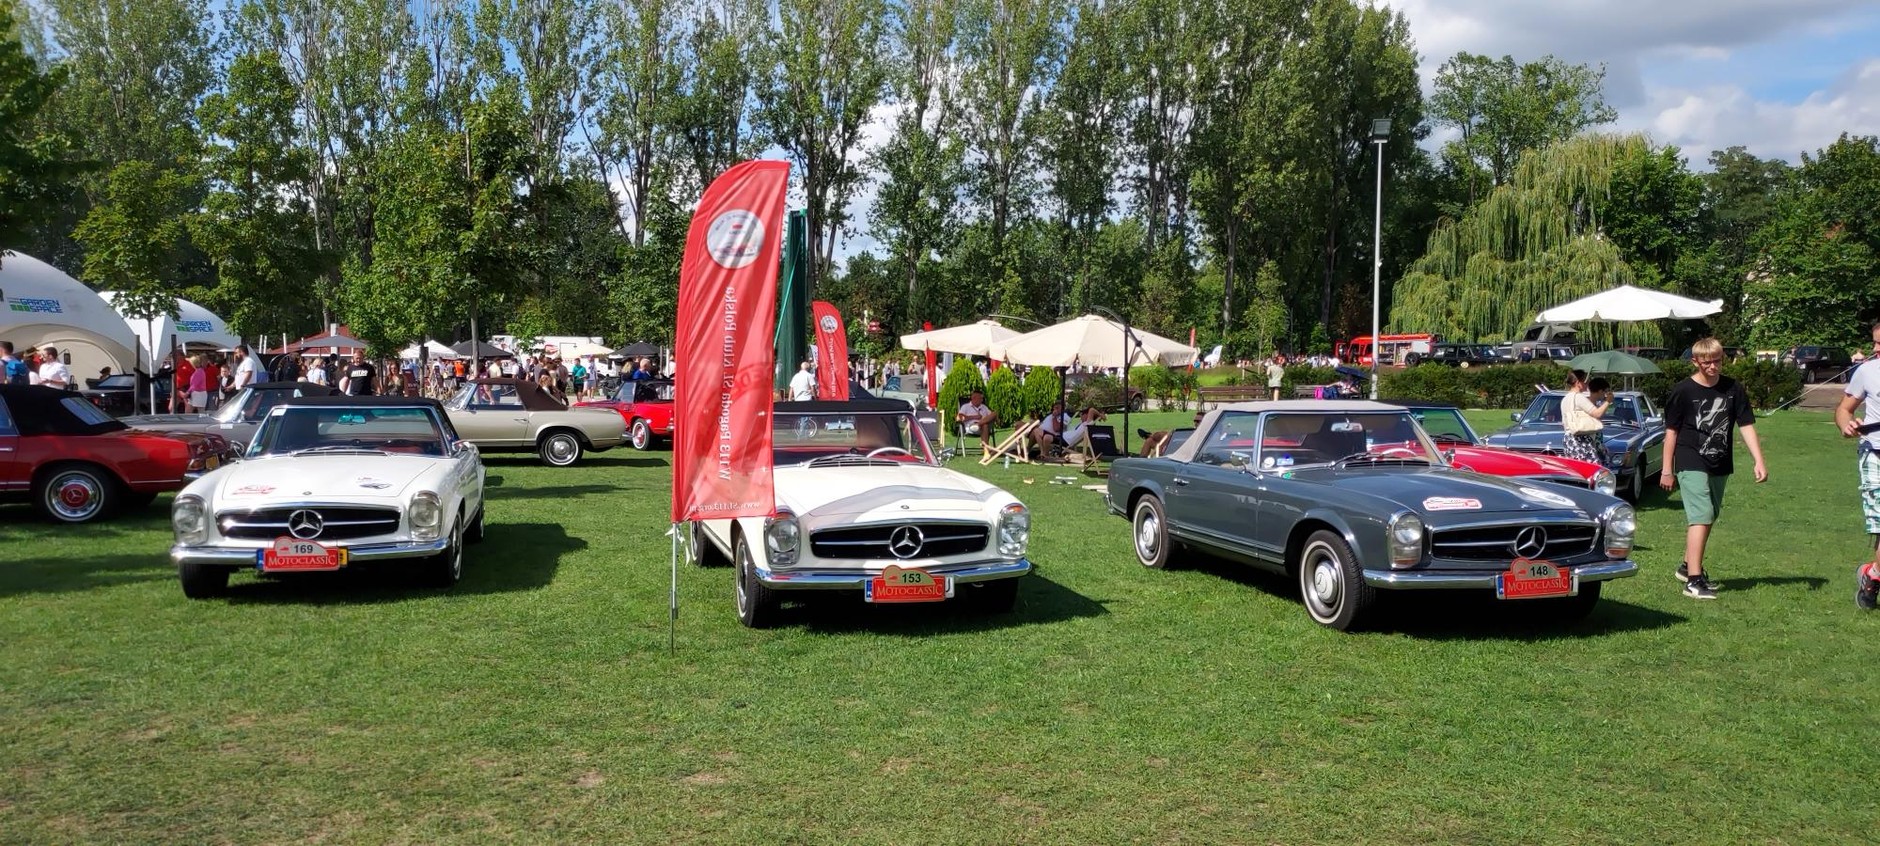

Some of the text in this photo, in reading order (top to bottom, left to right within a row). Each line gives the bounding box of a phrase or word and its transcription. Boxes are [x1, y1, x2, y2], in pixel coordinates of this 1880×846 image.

[20, 298, 60, 306] GARDEN
[30, 305, 63, 313] SPACE
[294, 544, 313, 554] 169
[268, 554, 336, 567] MOTOCLASSIC
[1530, 565, 1548, 577] 148
[902, 573, 921, 583] 153
[1506, 576, 1568, 593] MOTOCLASSIC
[876, 584, 943, 597] MOTOCLASSIC
